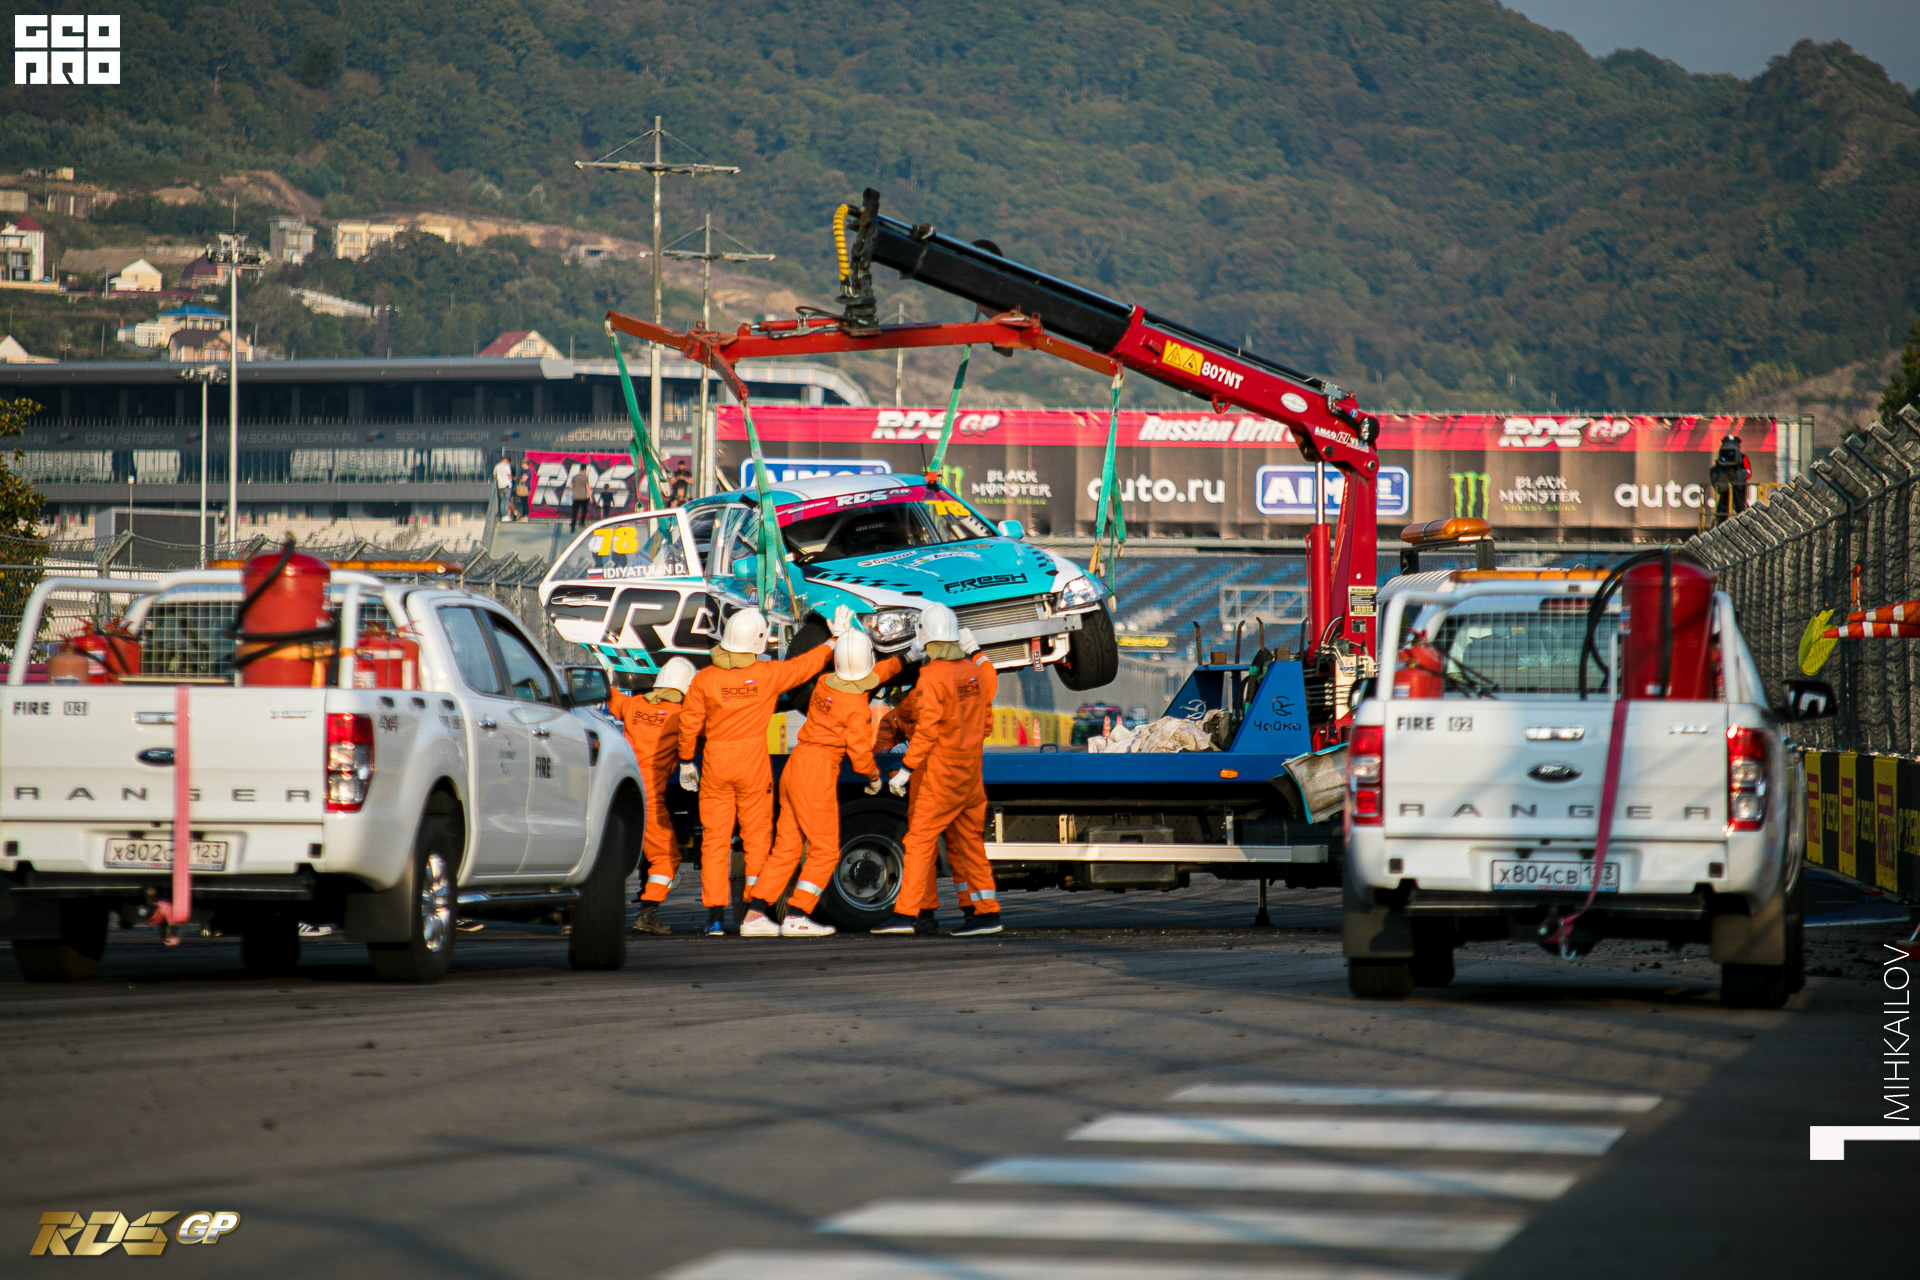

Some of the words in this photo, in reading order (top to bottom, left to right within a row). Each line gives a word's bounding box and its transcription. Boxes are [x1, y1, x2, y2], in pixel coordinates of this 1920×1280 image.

[1201, 361, 1244, 389] 807NT
[958, 414, 1000, 437] GP
[1139, 417, 1235, 442] Russian
[1498, 418, 1590, 448] RDS
[1588, 420, 1630, 442] GP
[986, 469, 1038, 483] BLACK
[1515, 475, 1566, 489] BLACK
[971, 483, 1052, 497] MONSTER
[1499, 488, 1582, 504] MONSTER
[836, 492, 889, 507] RDS
[925, 500, 971, 516] 78
[593, 526, 639, 556] 78
[603, 564, 672, 579] IDIYATULIN
[675, 562, 687, 575] D.
[721, 687, 758, 696] SOCHI
[13, 701, 50, 716] FIRE
[634, 710, 665, 724] SOCHI
[1397, 716, 1435, 731] FIRE
[1449, 716, 1473, 731] 02
[1253, 720, 1302, 732] Чайка
[534, 755, 551, 779] FIRE
[1399, 802, 1711, 821] RANGER
[192, 844, 221, 859] 123
